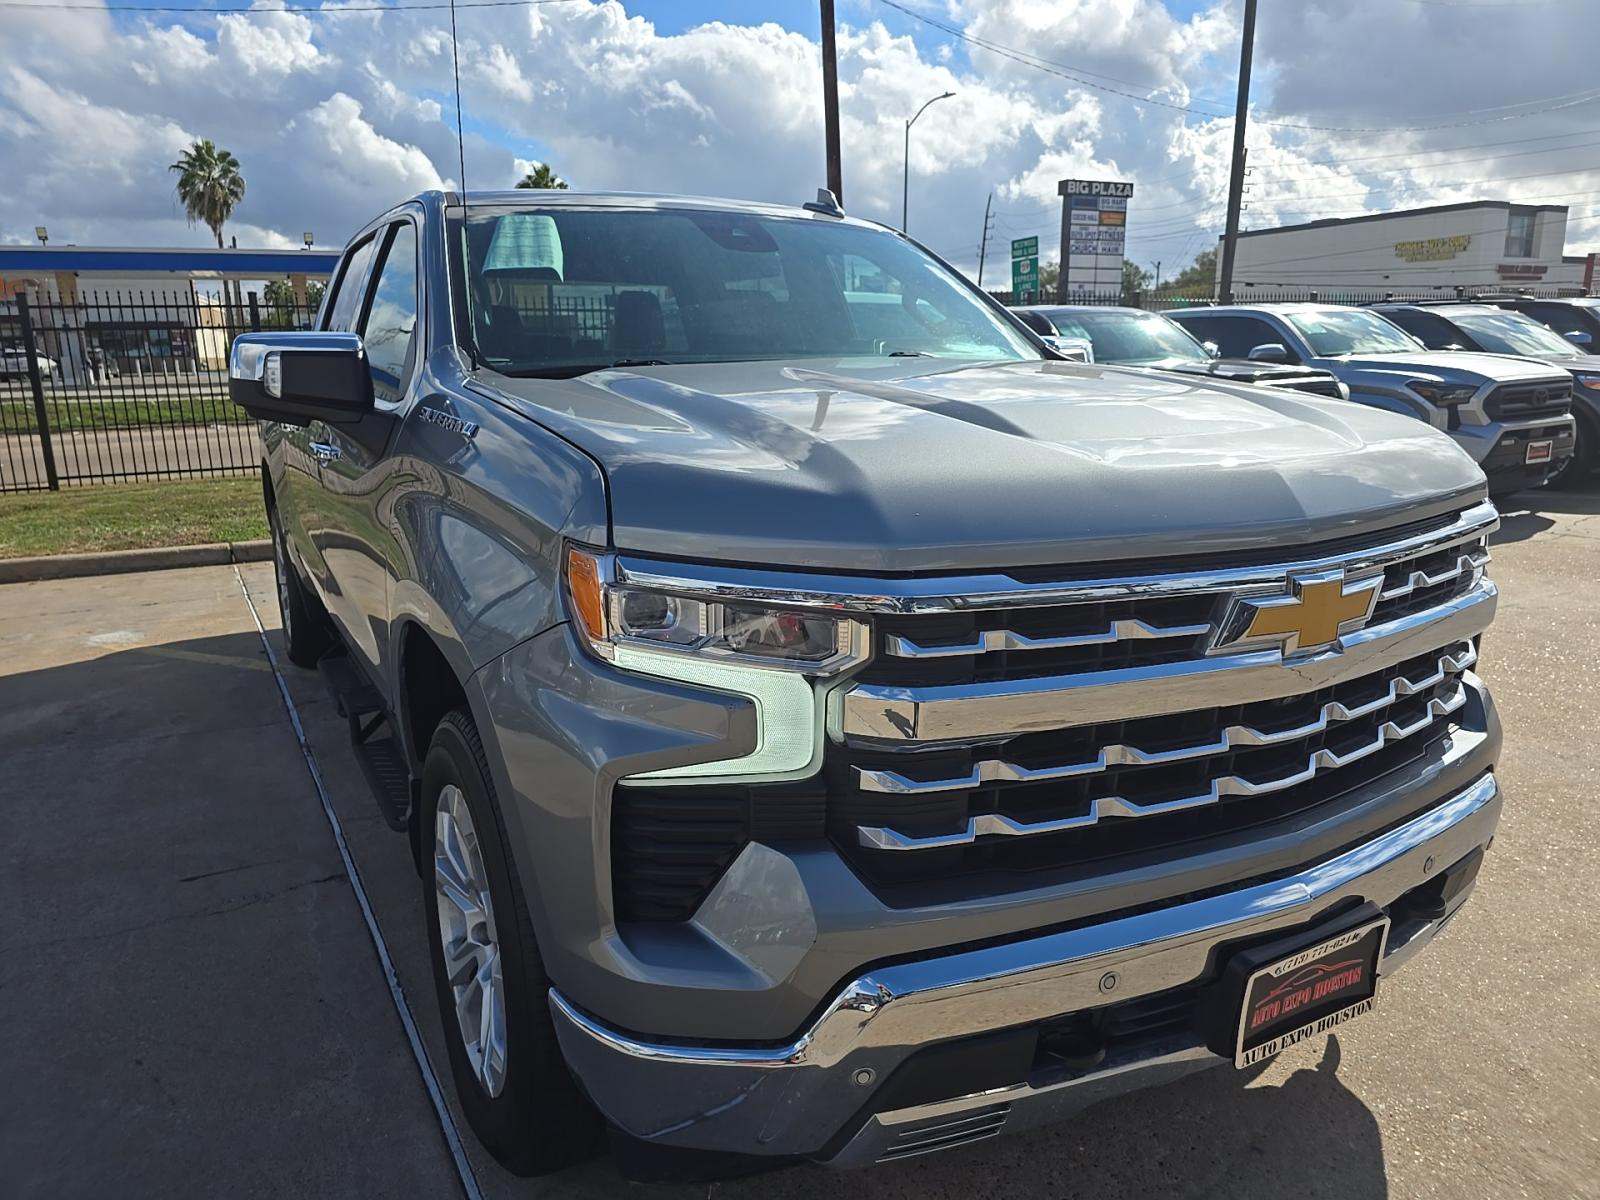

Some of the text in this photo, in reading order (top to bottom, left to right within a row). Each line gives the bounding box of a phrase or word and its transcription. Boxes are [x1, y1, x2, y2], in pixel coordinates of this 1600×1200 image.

[1067, 181, 1132, 196] BIG PLAZA
[1251, 966, 1362, 1029] AUTO EXPO HOUSTON
[1242, 999, 1373, 1067] AUTO EXPO HOUSTON
